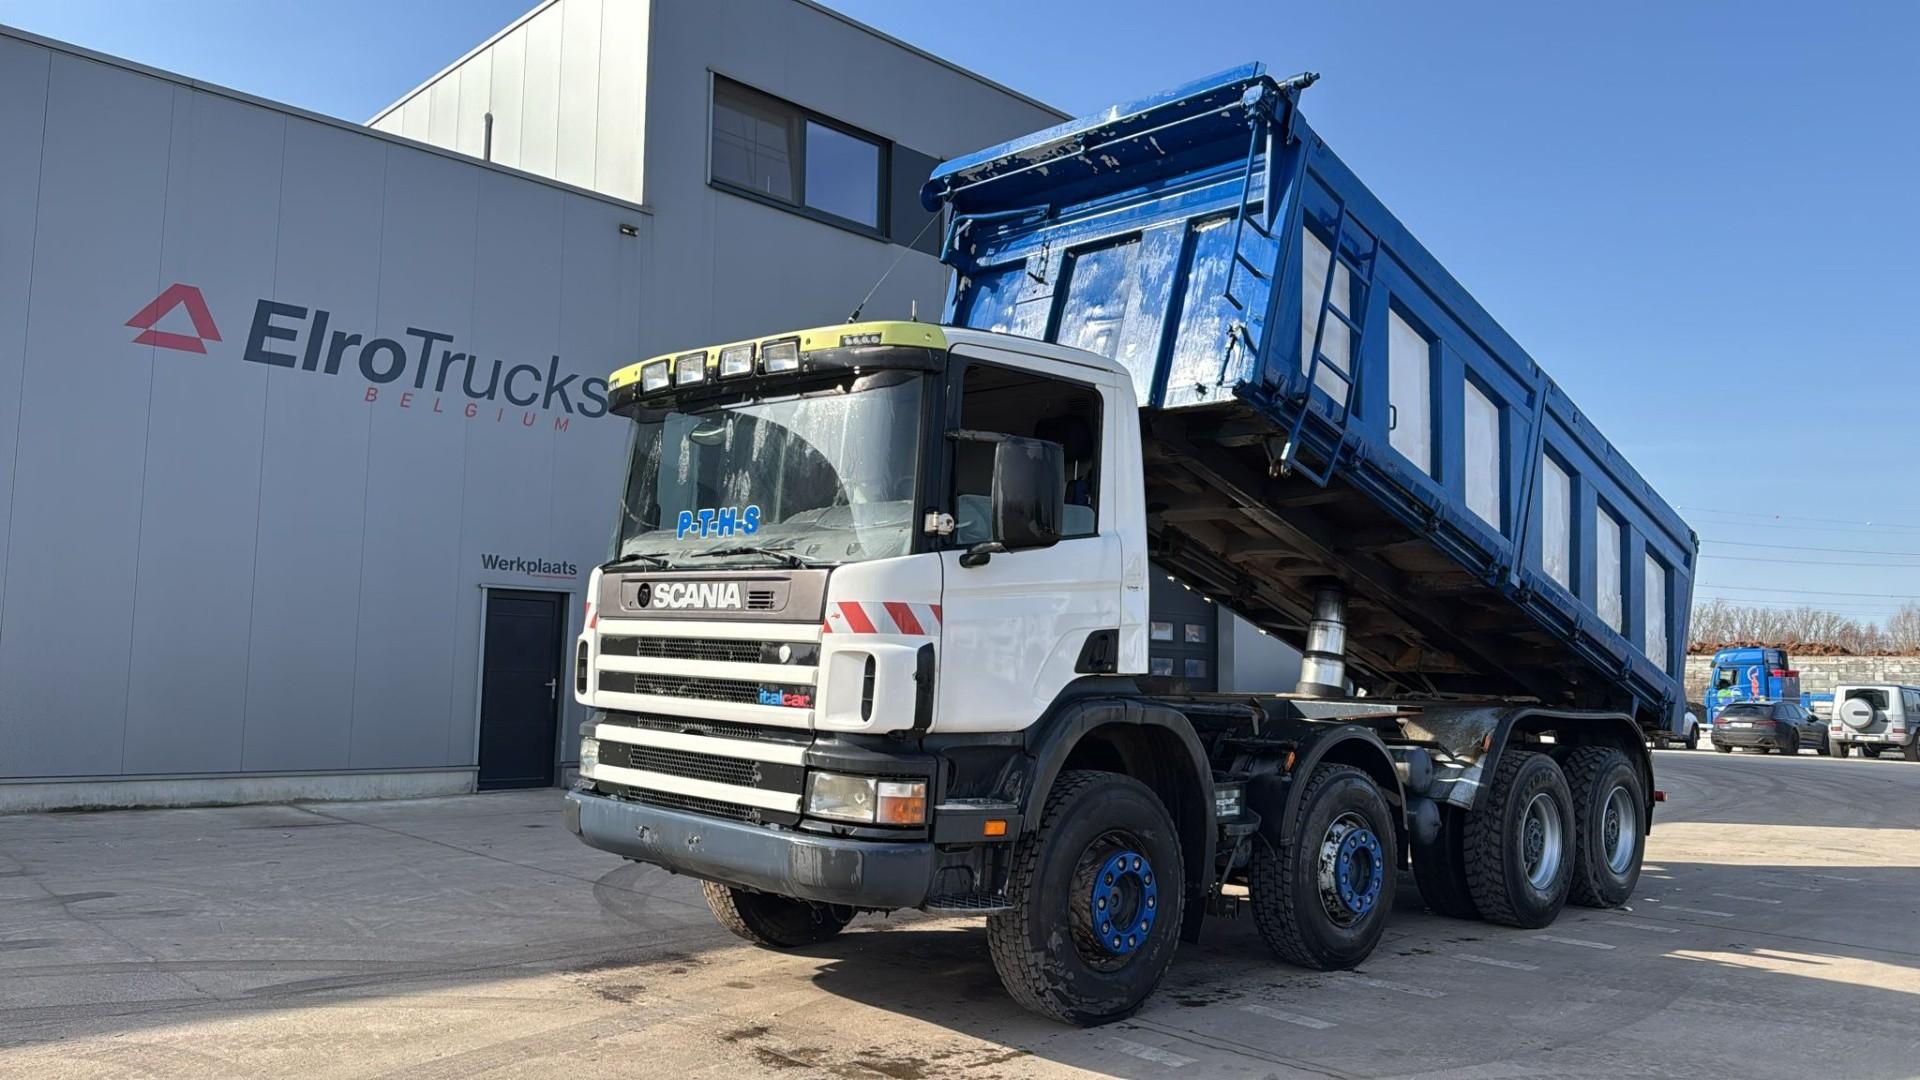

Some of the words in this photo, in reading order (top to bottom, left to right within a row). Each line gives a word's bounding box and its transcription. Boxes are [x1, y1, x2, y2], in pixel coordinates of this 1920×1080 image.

[243, 299, 608, 418] ElroTrucks
[364, 387, 570, 432] BELGIUM
[481, 553, 577, 576] Werkplaats
[653, 583, 742, 609] SCANIA
